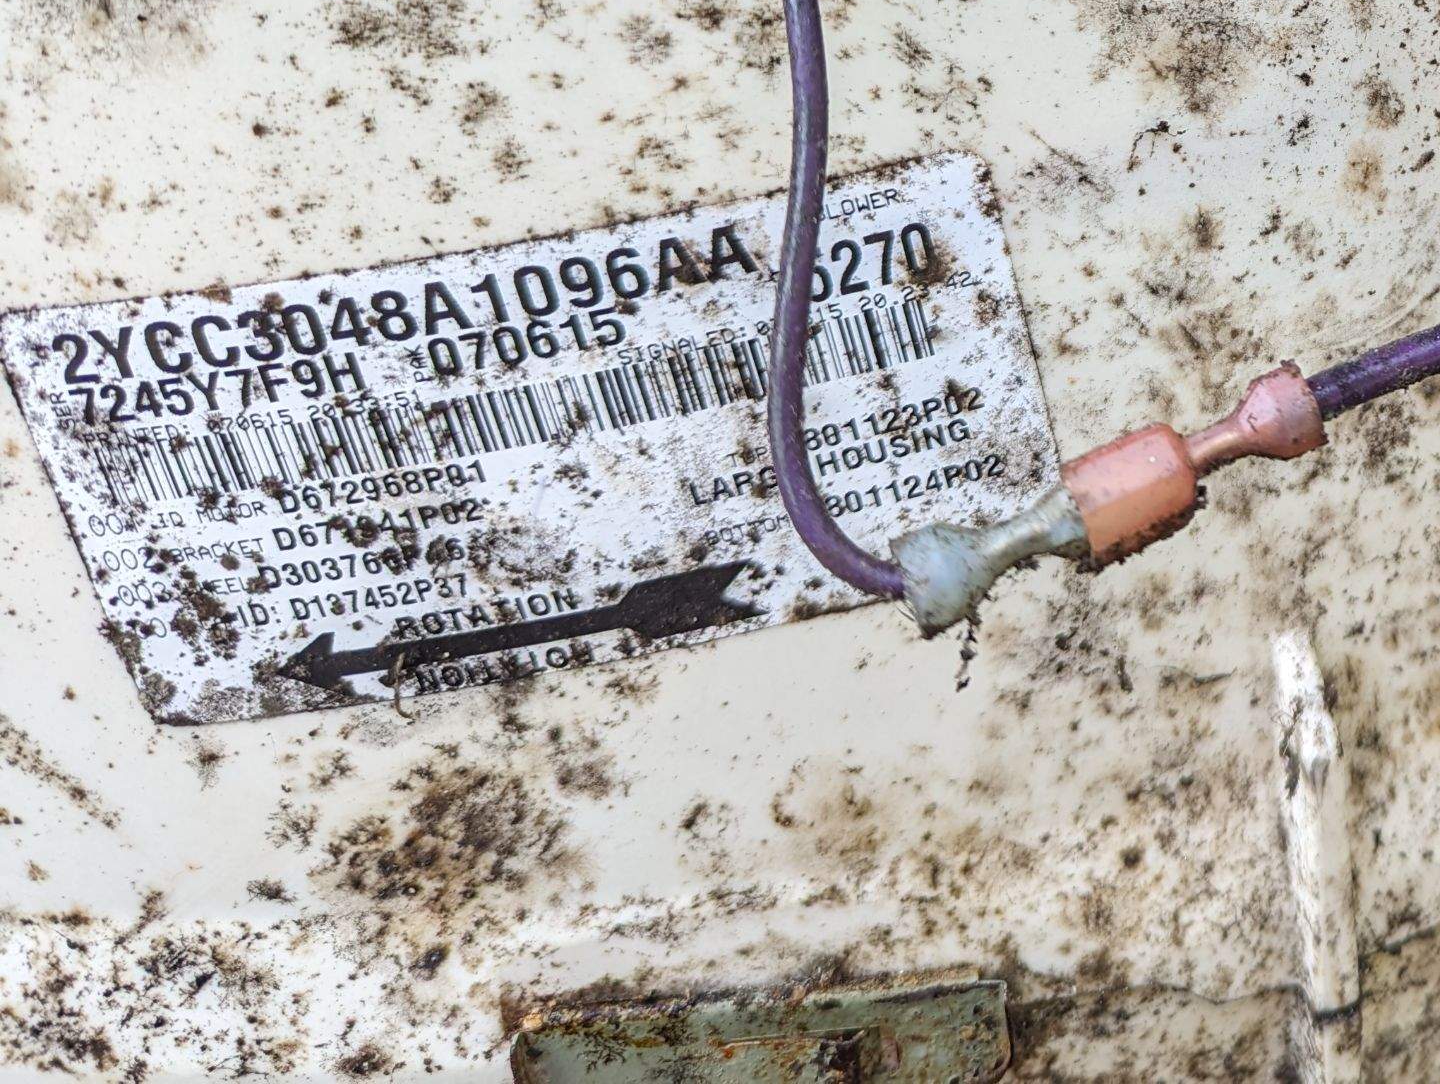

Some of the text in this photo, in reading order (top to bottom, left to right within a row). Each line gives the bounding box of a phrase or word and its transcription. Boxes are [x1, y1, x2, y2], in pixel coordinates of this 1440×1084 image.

[820, 188, 901, 221] LOWER
[52, 224, 759, 385] 2YCC3048A1096AA
[427, 307, 627, 377] 070615
[68, 352, 367, 426] 7245Y7F9H
[279, 460, 487, 514] D672968P01
[689, 418, 972, 506] LARG HOUSING
[170, 537, 264, 564] BRACKET
[289, 573, 467, 621] D137452P37
[394, 587, 582, 638] ROTATION
